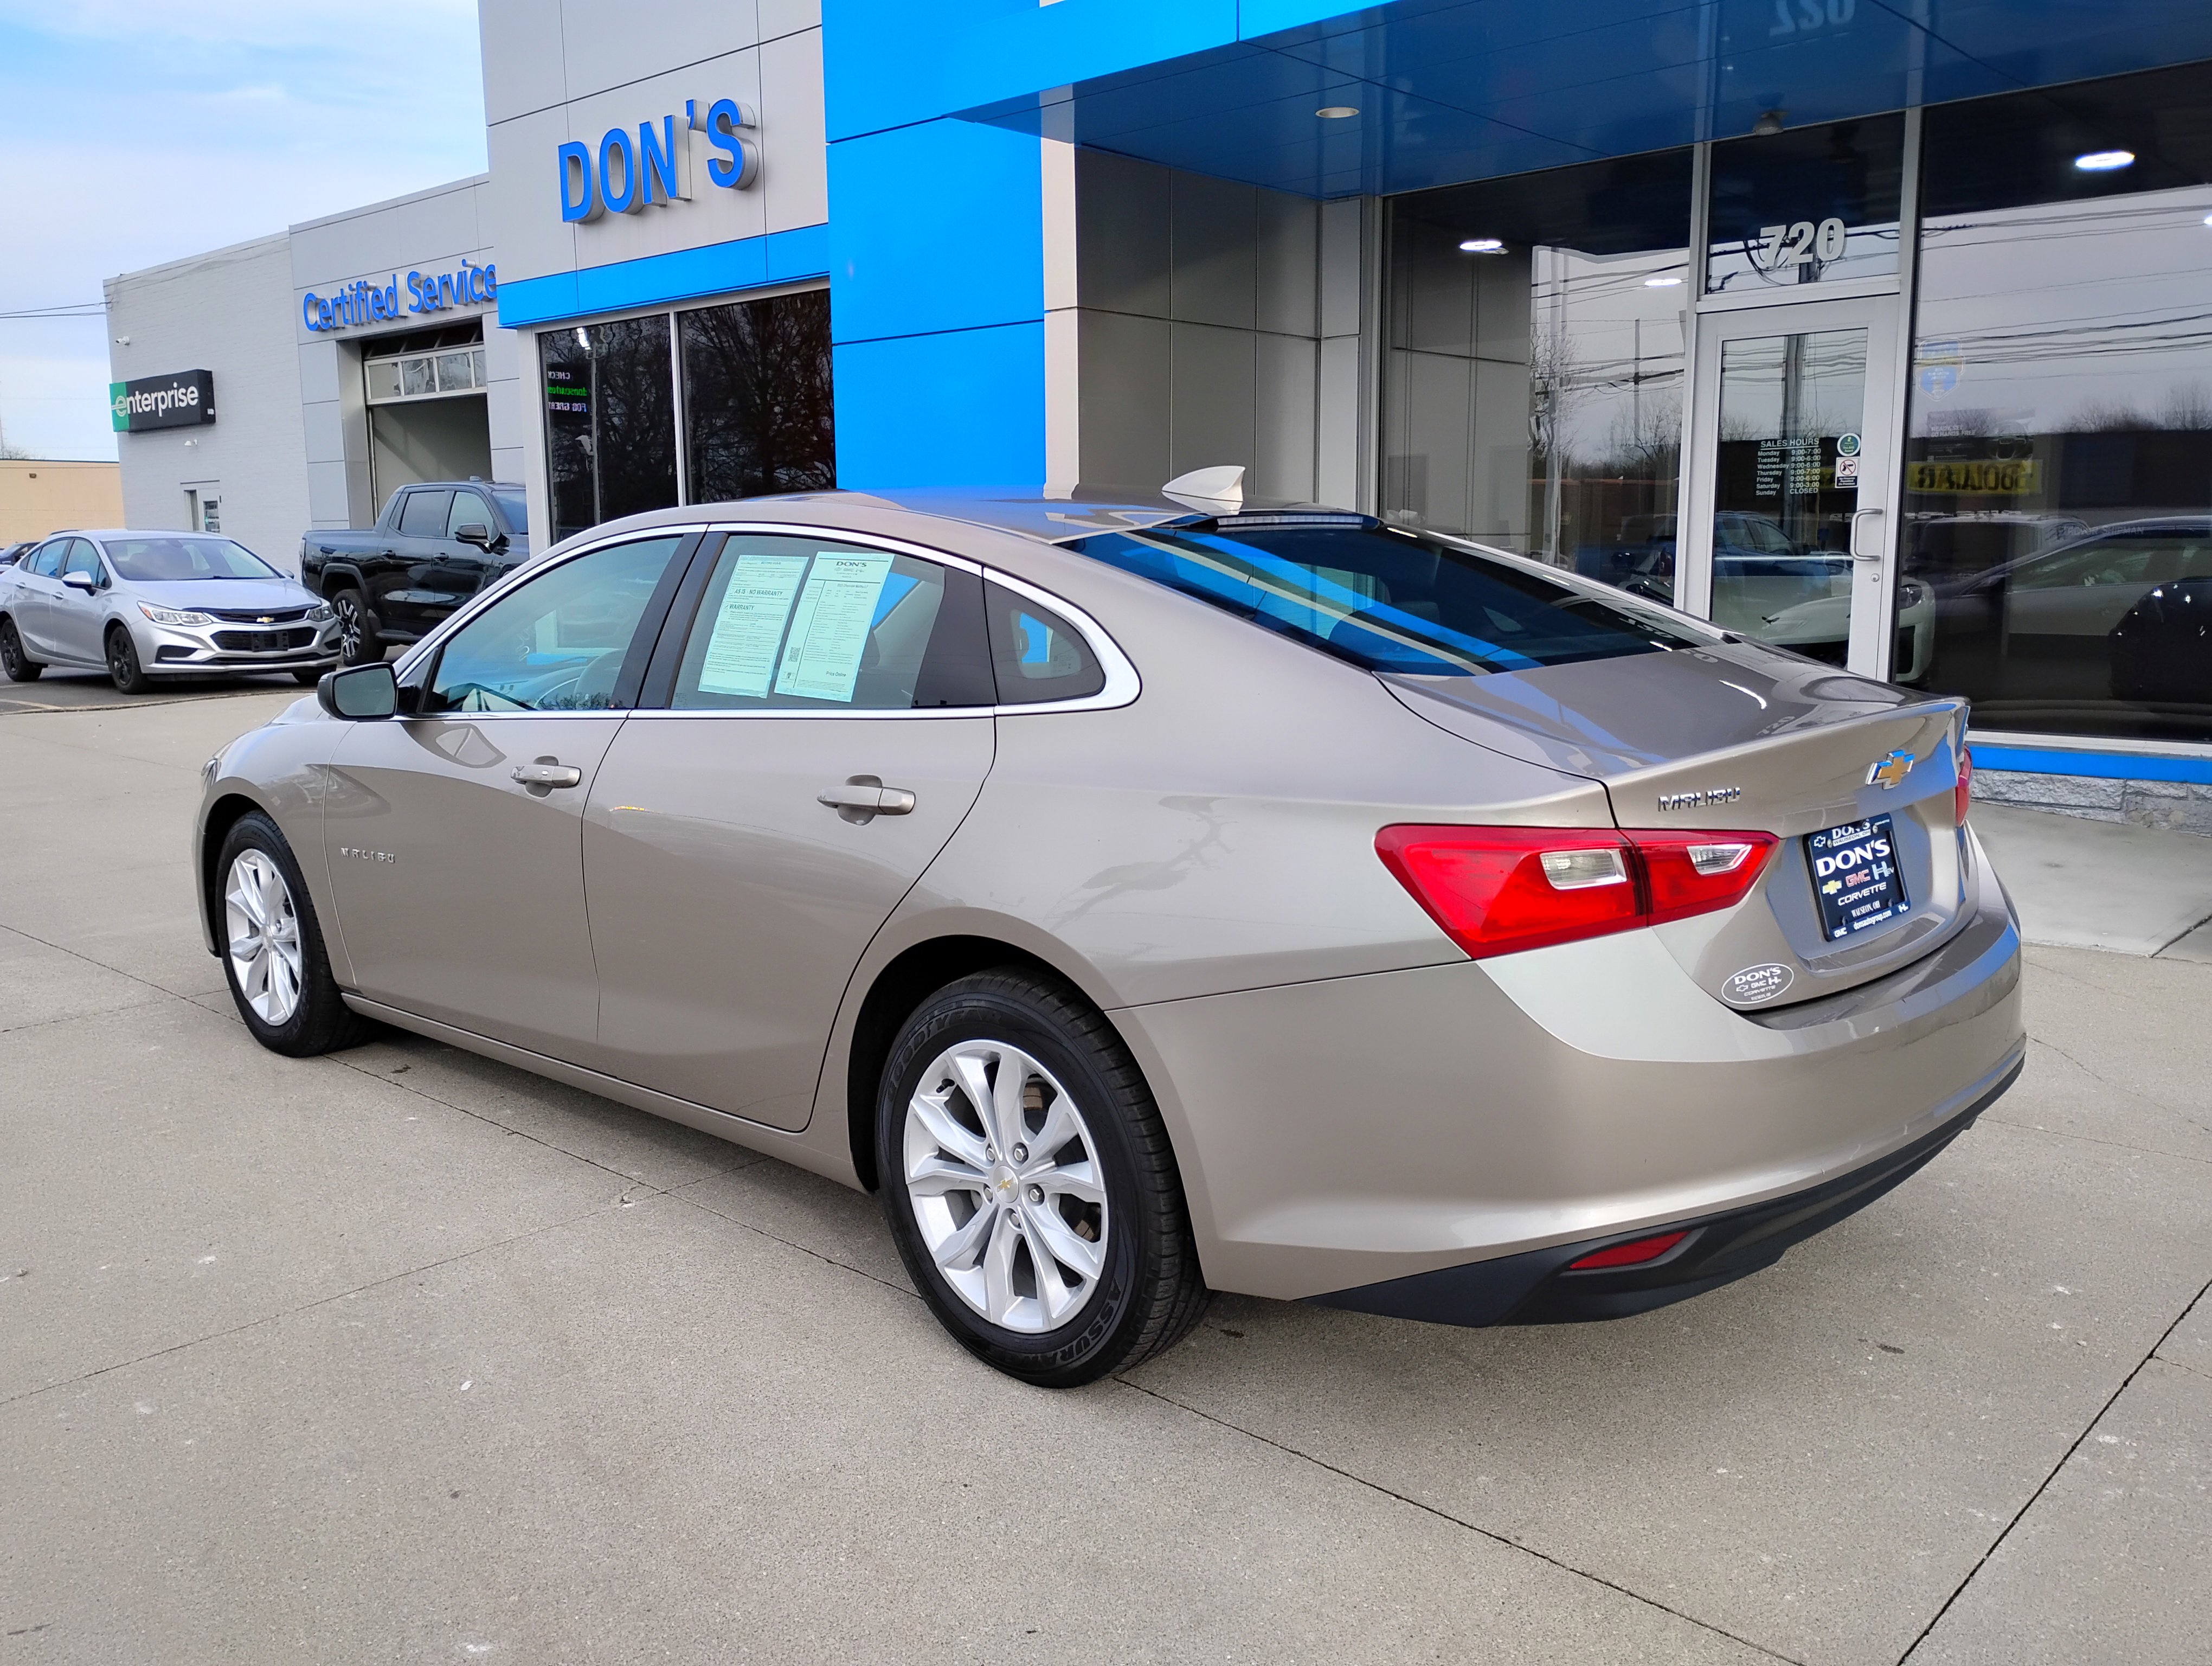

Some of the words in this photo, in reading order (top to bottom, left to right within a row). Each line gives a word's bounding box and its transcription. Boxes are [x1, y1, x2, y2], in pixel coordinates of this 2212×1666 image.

[558, 99, 756, 223] DON'S
[1760, 217, 1845, 268] 720
[303, 274, 399, 331] Certified
[407, 259, 497, 313] Service
[111, 382, 198, 417] enterprise
[1760, 440, 1787, 448] SALES
[1790, 438, 1819, 446] HOURS
[1658, 787, 1740, 811] MALIBU
[1833, 834, 1862, 845] WAUSEON,
[340, 847, 395, 863] MALIBU
[1816, 838, 1891, 877] DON'S
[1846, 869, 1871, 887] GMC
[1838, 882, 1887, 906] CORVETTE
[1873, 900, 1881, 909] OH
[1834, 927, 1848, 938] GMC
[1853, 909, 1893, 930] donsautogroup.com
[1734, 967, 1781, 985] DON'S
[1751, 980, 1767, 989] GMC
[1744, 985, 1776, 996] CORVETTE
